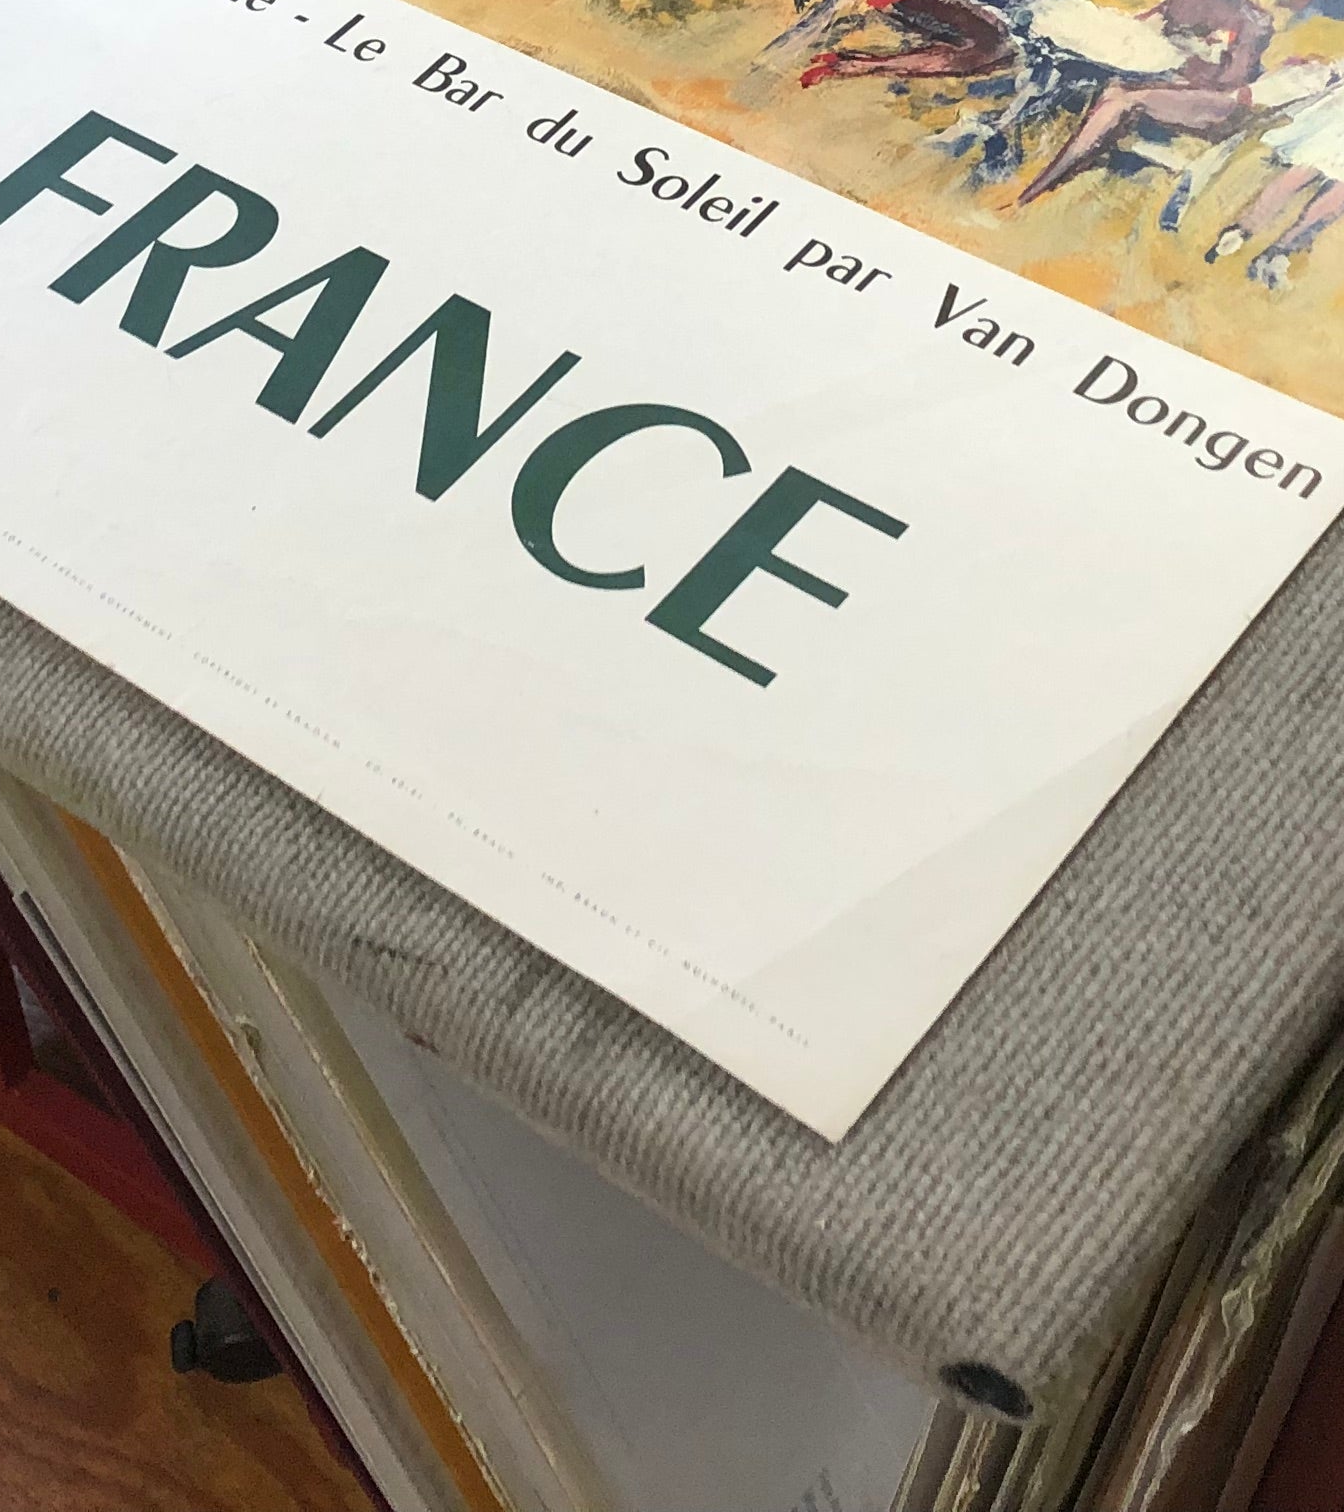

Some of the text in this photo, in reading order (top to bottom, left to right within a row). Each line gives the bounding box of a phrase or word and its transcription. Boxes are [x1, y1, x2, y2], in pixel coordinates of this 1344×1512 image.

[323, 13, 387, 62] Le
[412, 52, 505, 113] Bar
[526, 108, 594, 158] du
[616, 145, 780, 239] Soleil
[782, 238, 893, 294] par
[933, 282, 1036, 367] Van
[1072, 354, 1324, 500] Dongen
